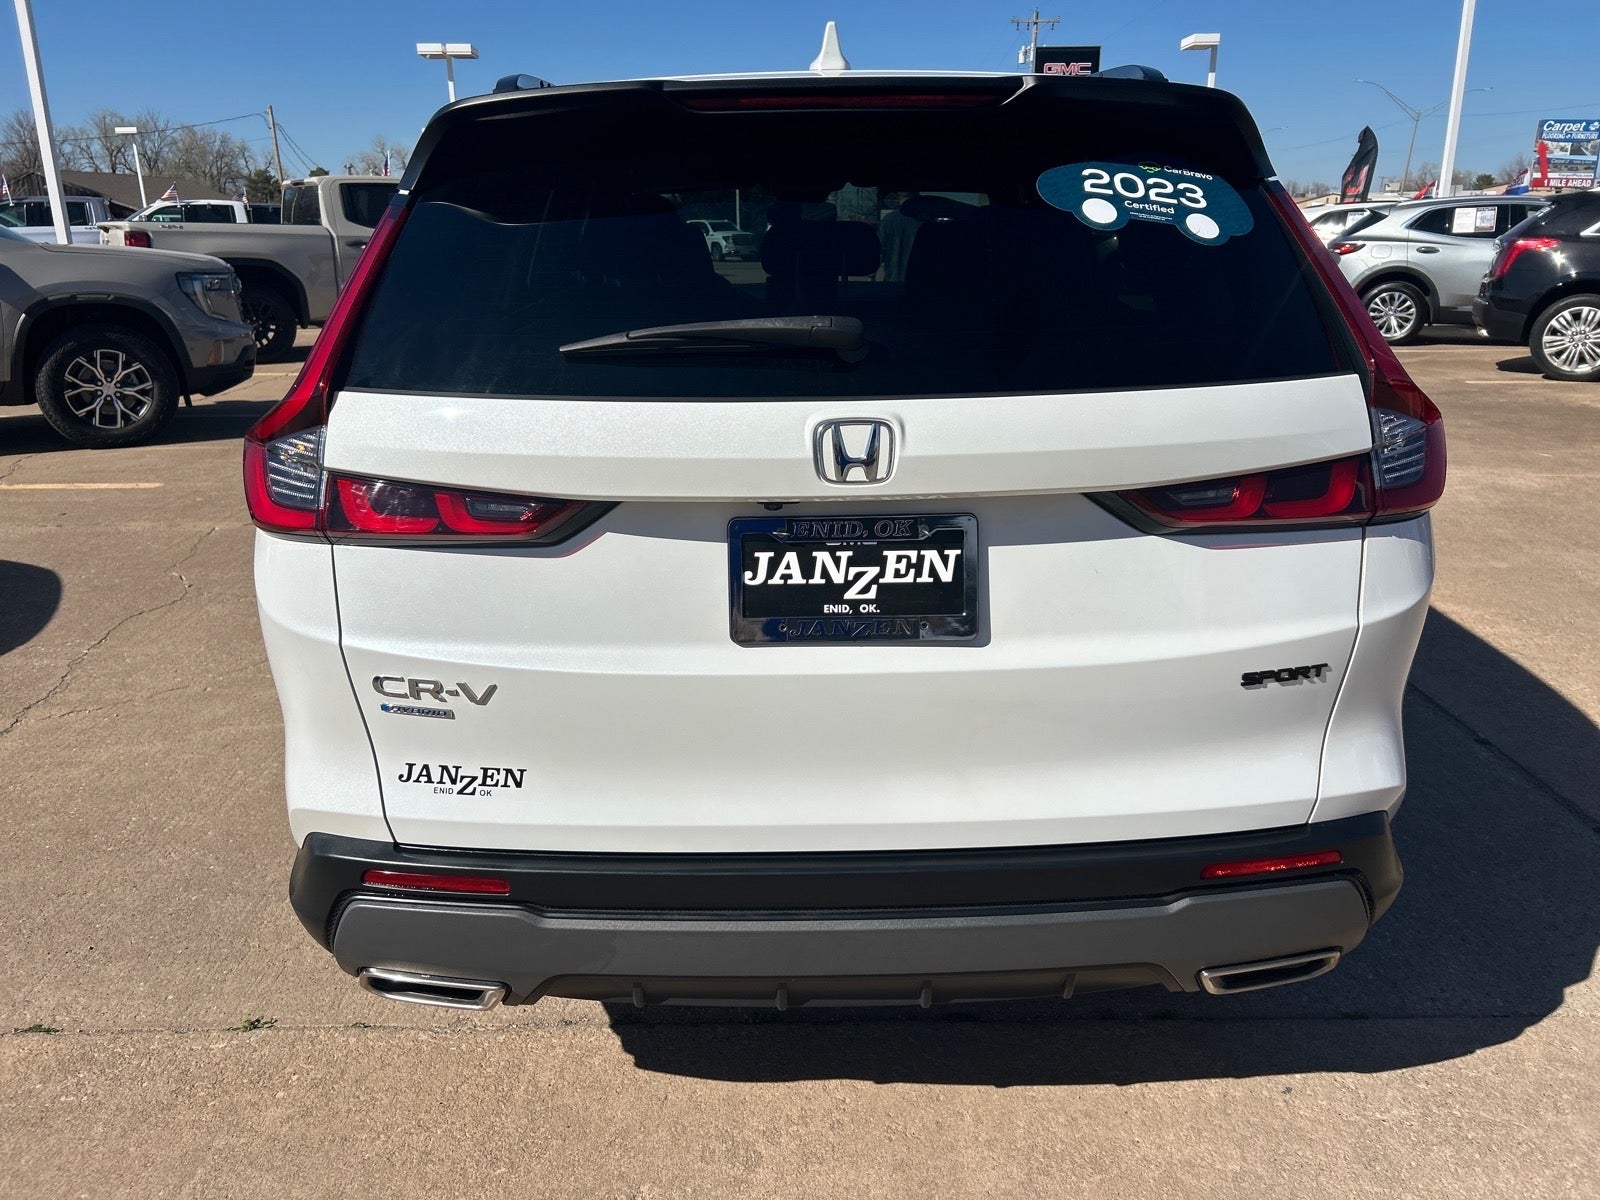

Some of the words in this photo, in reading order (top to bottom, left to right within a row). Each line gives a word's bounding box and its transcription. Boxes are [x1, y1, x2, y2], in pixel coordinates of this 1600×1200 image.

[1044, 63, 1092, 75] GMC
[1543, 120, 1587, 133] Carpet
[1163, 165, 1213, 181] CarBravo
[1081, 168, 1208, 209] 2023
[1543, 179, 1548, 187] 1
[1549, 179, 1567, 187] MILE
[1567, 179, 1592, 187] AHEAD
[1124, 200, 1175, 214] Certified
[791, 520, 869, 538] ENID,
[874, 519, 914, 537] OK
[744, 549, 962, 600] JANZEN
[823, 604, 853, 614] ENID,
[859, 603, 880, 613] OK.
[789, 618, 918, 638] JANZEN
[1240, 662, 1329, 687] SPORT
[372, 675, 498, 706] CR-V
[398, 762, 527, 796] JANZEN
[433, 786, 454, 795] ENID
[479, 789, 493, 797] OK
